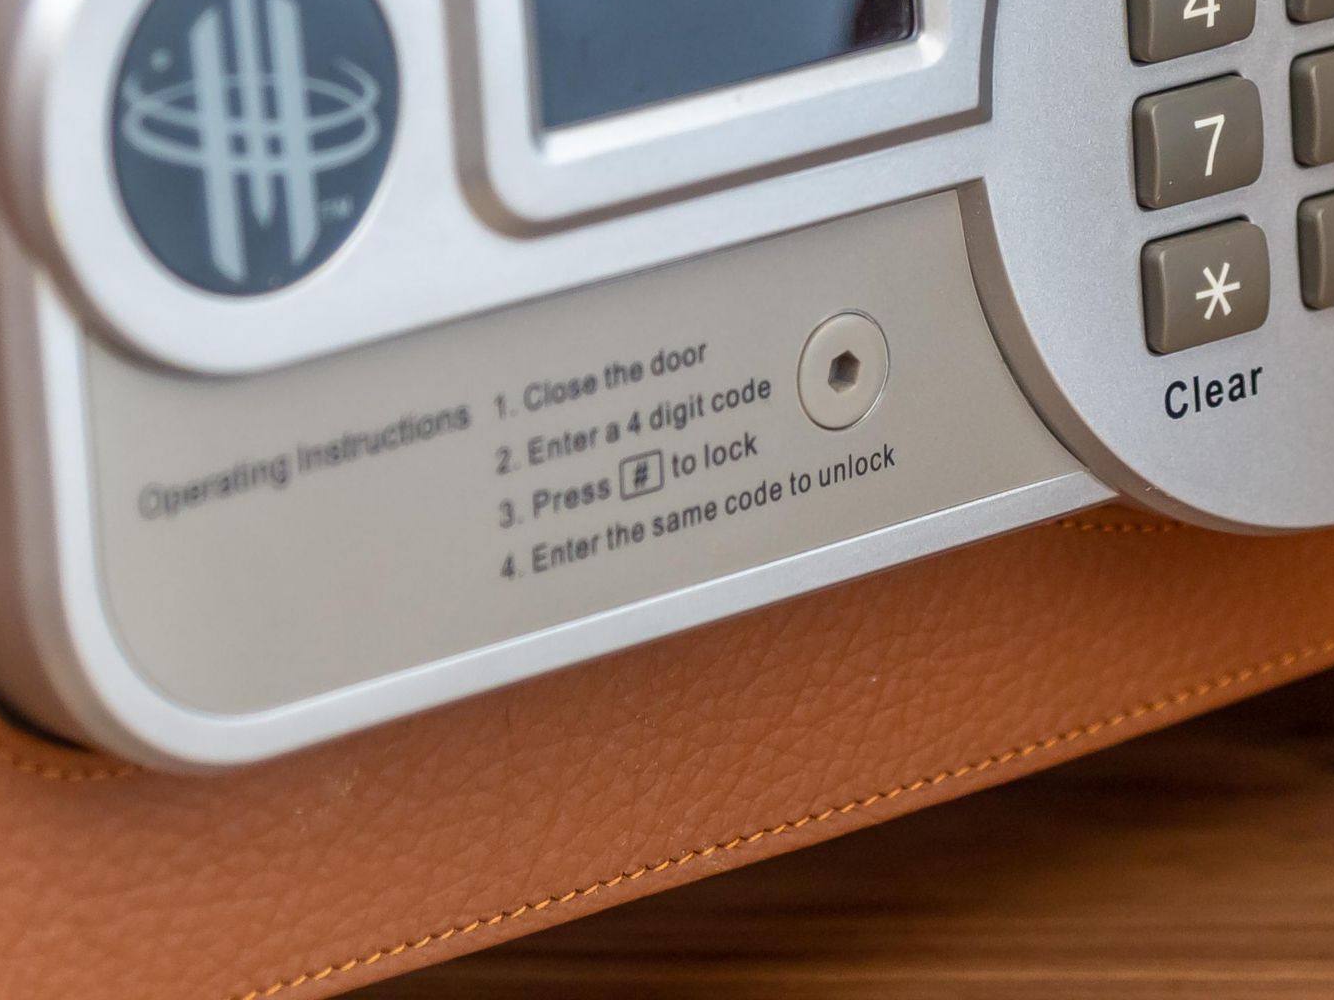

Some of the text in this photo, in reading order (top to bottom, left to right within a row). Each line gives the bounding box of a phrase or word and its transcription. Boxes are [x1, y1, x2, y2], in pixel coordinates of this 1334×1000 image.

[1194, 114, 1227, 177] 7
[523, 373, 598, 412] Close
[603, 361, 644, 389] the
[650, 343, 707, 377] door
[1164, 366, 1265, 421] Clear
[138, 404, 472, 520] Operating Instructions
[527, 427, 598, 466] Enter
[605, 422, 621, 444] a
[627, 410, 642, 435] 4
[649, 394, 705, 431] digit
[711, 378, 771, 412] code
[531, 477, 611, 519] Press
[632, 460, 649, 489] #
[671, 454, 696, 478] to
[705, 432, 758, 468] lock
[531, 533, 600, 575] Enter
[606, 522, 646, 552] the
[652, 501, 717, 538] same
[725, 479, 783, 516] code
[789, 471, 812, 497] to
[818, 442, 896, 487] unlock
